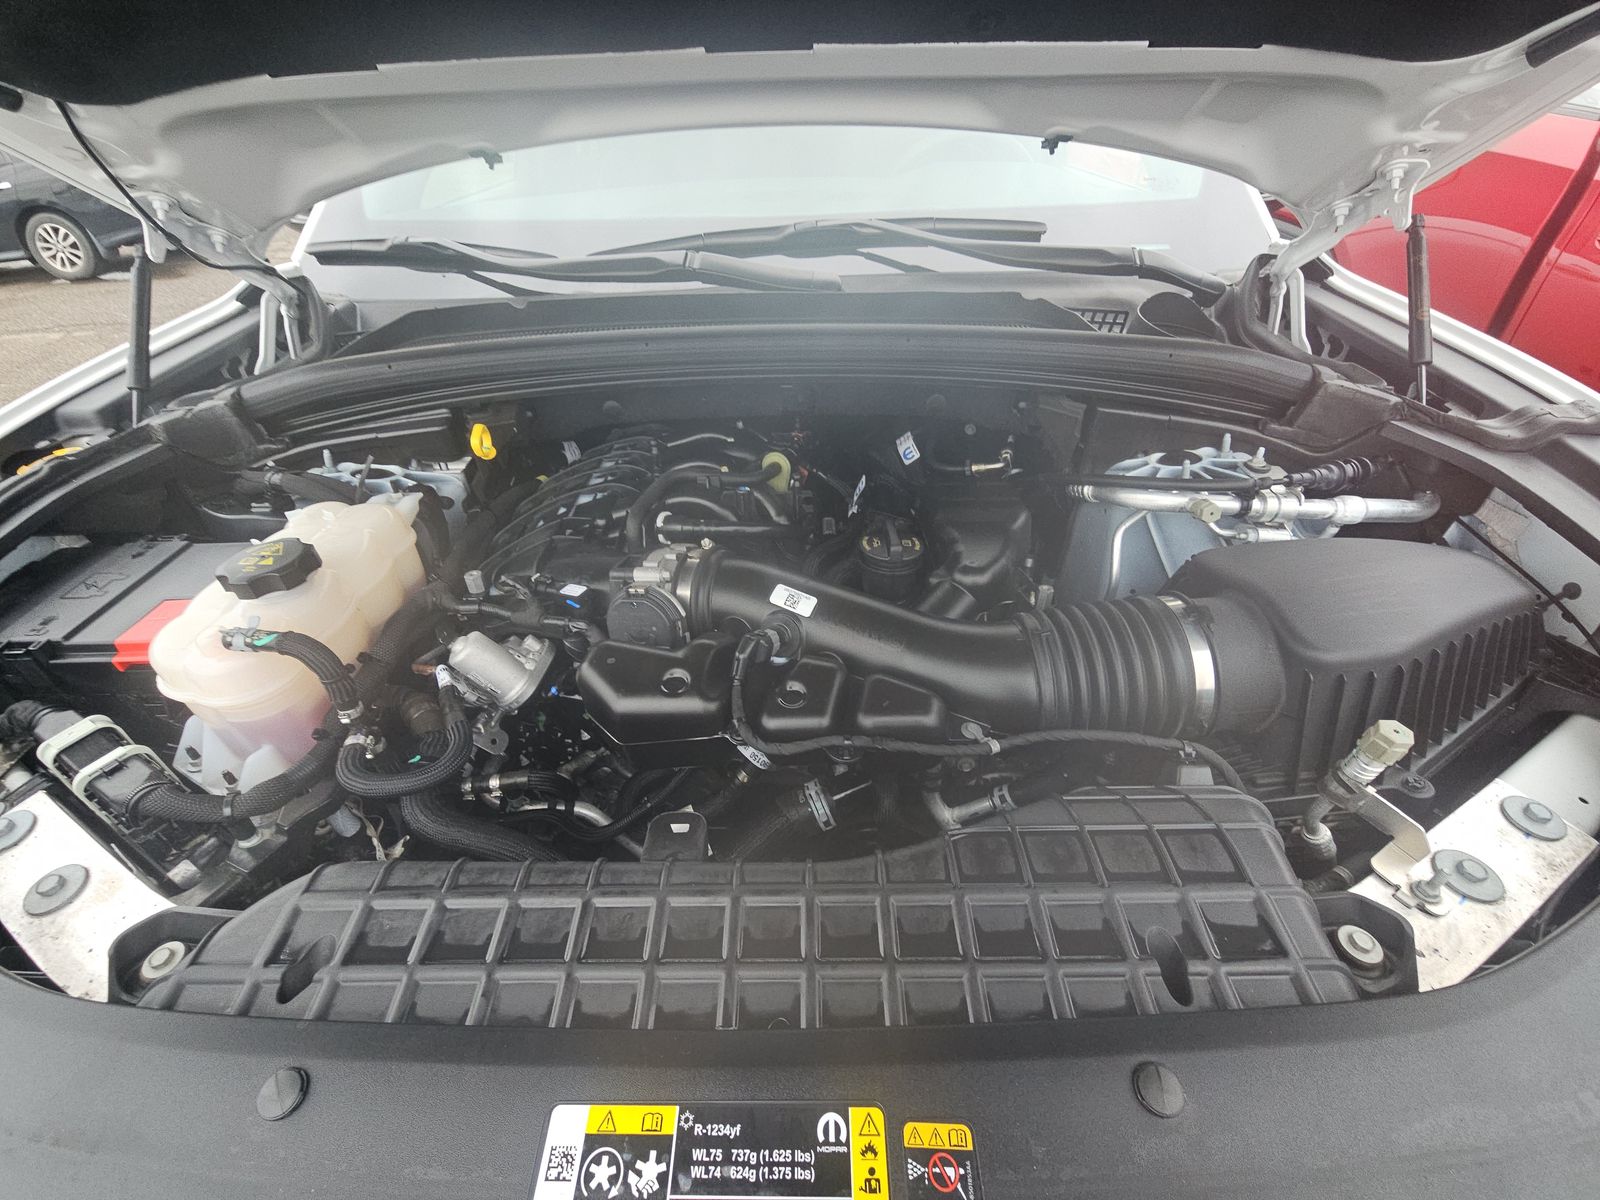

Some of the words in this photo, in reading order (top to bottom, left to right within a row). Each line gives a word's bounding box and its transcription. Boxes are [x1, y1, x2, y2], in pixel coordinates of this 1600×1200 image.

[693, 1124, 742, 1139] R-1234yf
[692, 1149, 723, 1162] WL75
[731, 1149, 757, 1164] 737g
[759, 1149, 792, 1164] (1.625
[794, 1149, 816, 1164] lbs)
[816, 1145, 848, 1153] MOPAR
[690, 1165, 722, 1179] WL74
[730, 1166, 757, 1182] 624g
[758, 1166, 792, 1182] (1.375
[794, 1166, 816, 1182] lbs)
